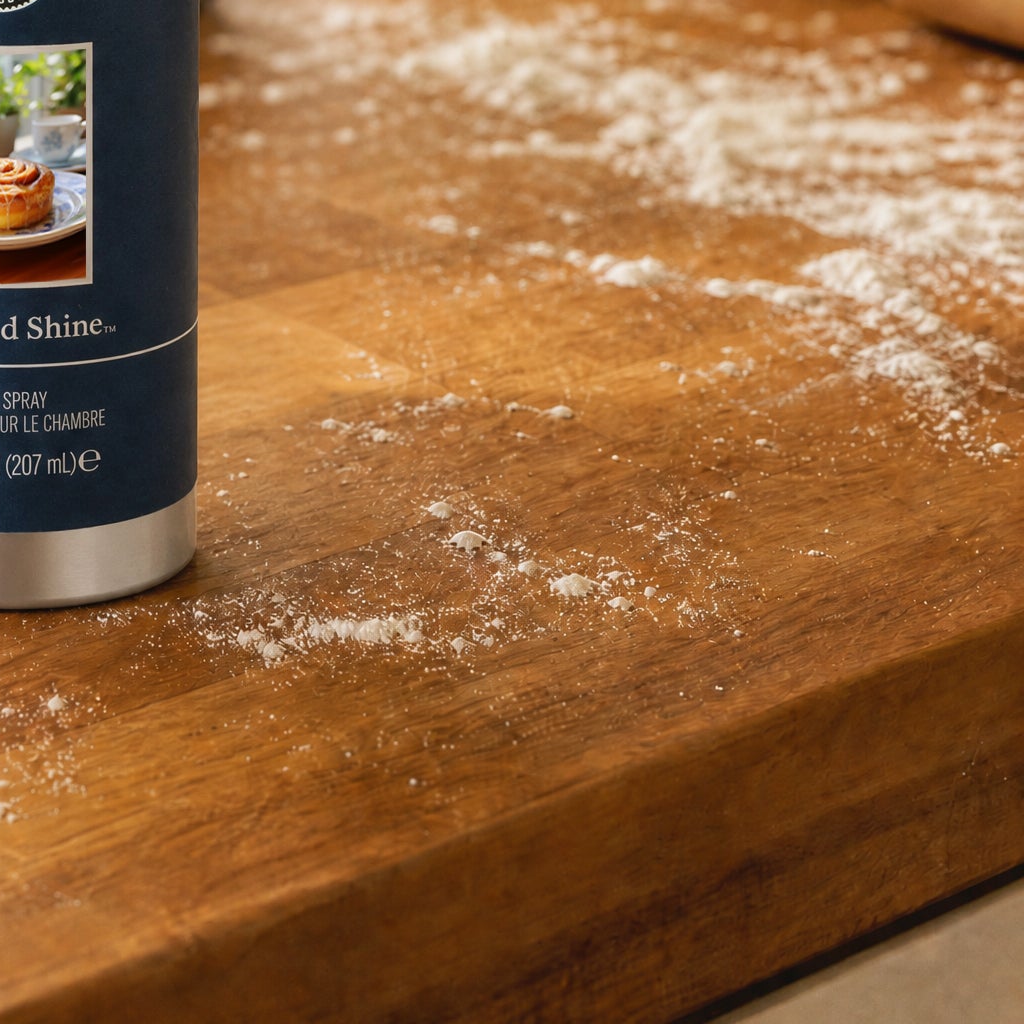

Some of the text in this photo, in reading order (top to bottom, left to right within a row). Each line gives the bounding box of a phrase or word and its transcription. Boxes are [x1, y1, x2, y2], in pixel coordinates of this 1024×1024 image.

[3, 391, 48, 410] SPRAY
[23, 415, 39, 433] LE
[43, 409, 106, 432] CHAMBRE
[5, 454, 42, 479] (207
